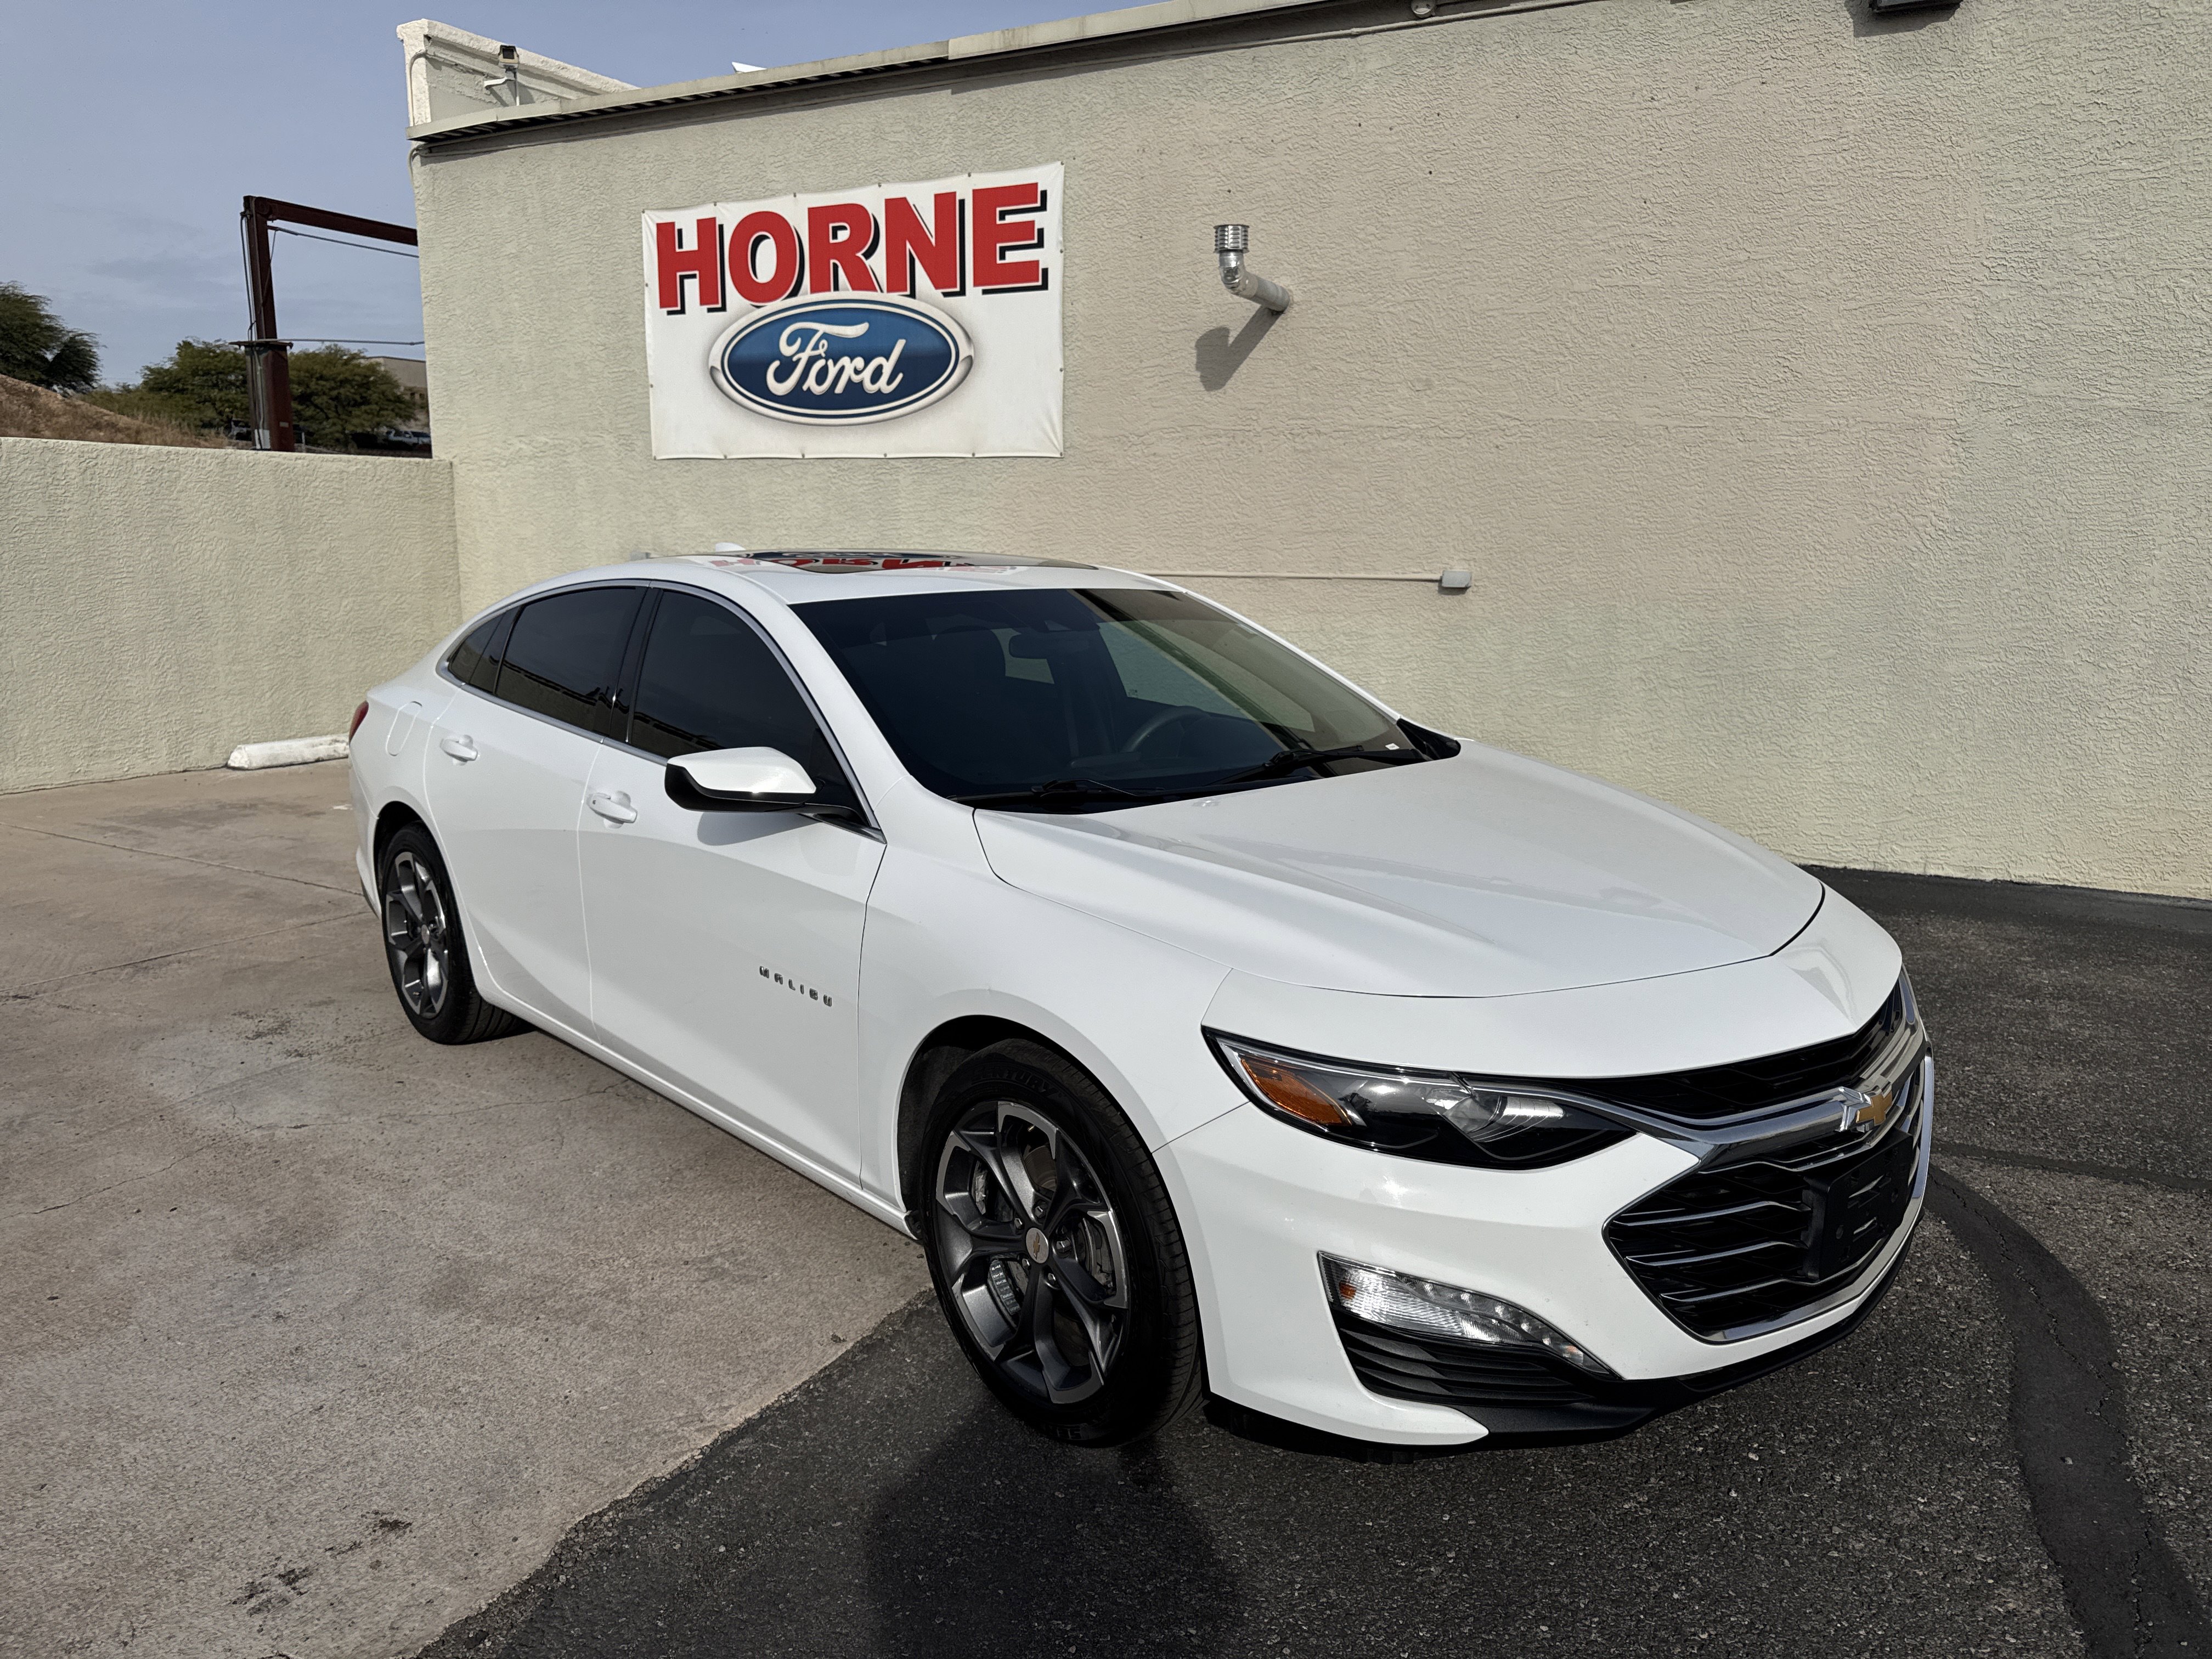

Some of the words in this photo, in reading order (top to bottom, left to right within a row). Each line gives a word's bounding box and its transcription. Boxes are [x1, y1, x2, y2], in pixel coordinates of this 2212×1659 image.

[656, 182, 1048, 315] HORNE
[766, 321, 907, 396] Ford
[759, 966, 832, 1007] MALIBU
